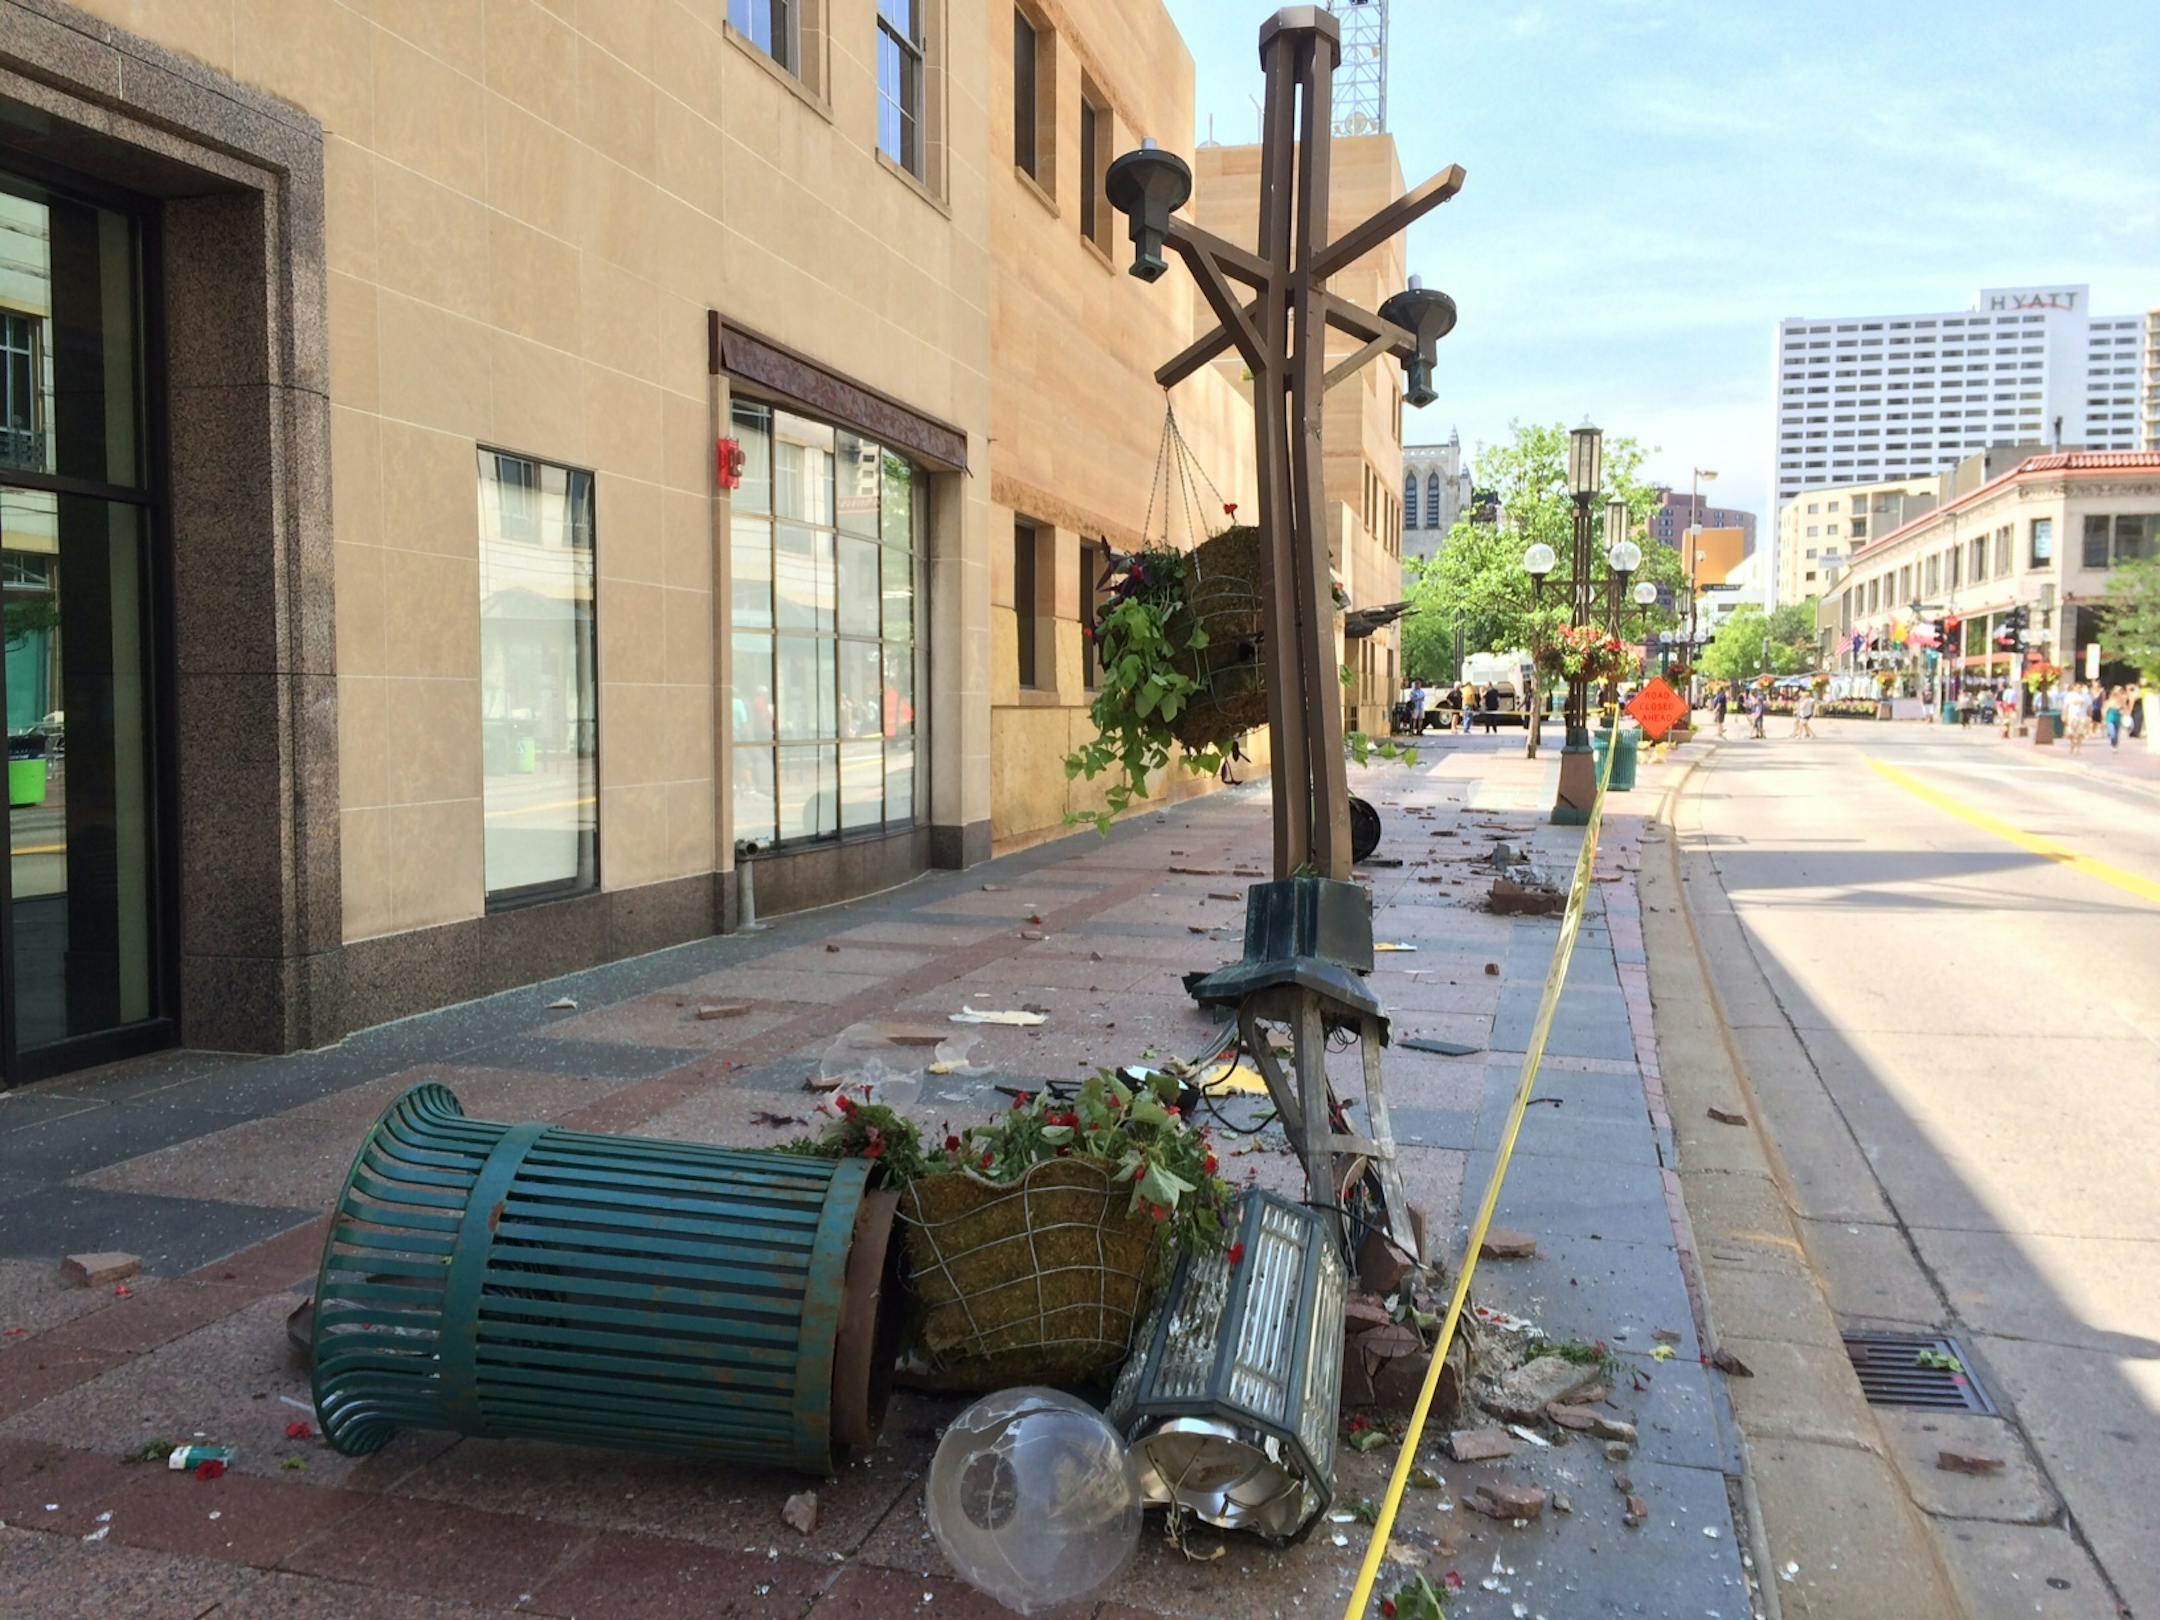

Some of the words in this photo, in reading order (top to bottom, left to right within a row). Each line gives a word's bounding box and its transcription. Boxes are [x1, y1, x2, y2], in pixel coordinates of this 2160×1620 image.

[1990, 292, 2078, 311] HYATT
[1645, 691, 1670, 700] ROAD
[1640, 702, 1674, 711] CLOSED
[1641, 713, 1673, 722] AHEAD
